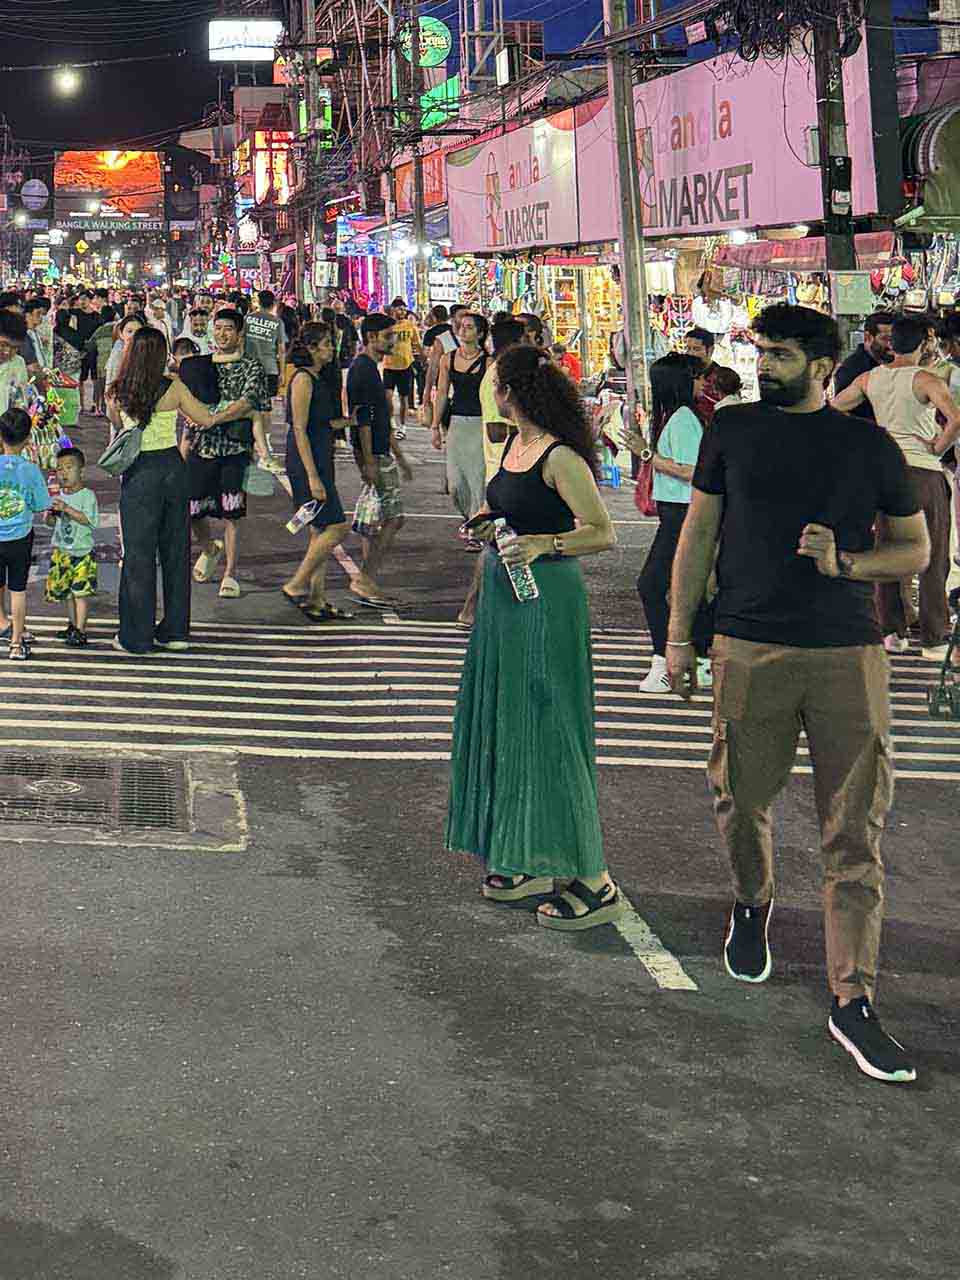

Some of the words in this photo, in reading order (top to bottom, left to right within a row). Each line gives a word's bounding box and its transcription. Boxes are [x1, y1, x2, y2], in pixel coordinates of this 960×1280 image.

[658, 162, 754, 229] MARKET
[56, 220, 90, 230] BANGLA
[91, 220, 131, 231] WALKING
[132, 222, 164, 231] STREET
[504, 200, 550, 247] MARKET
[245, 316, 280, 330] GALLERY
